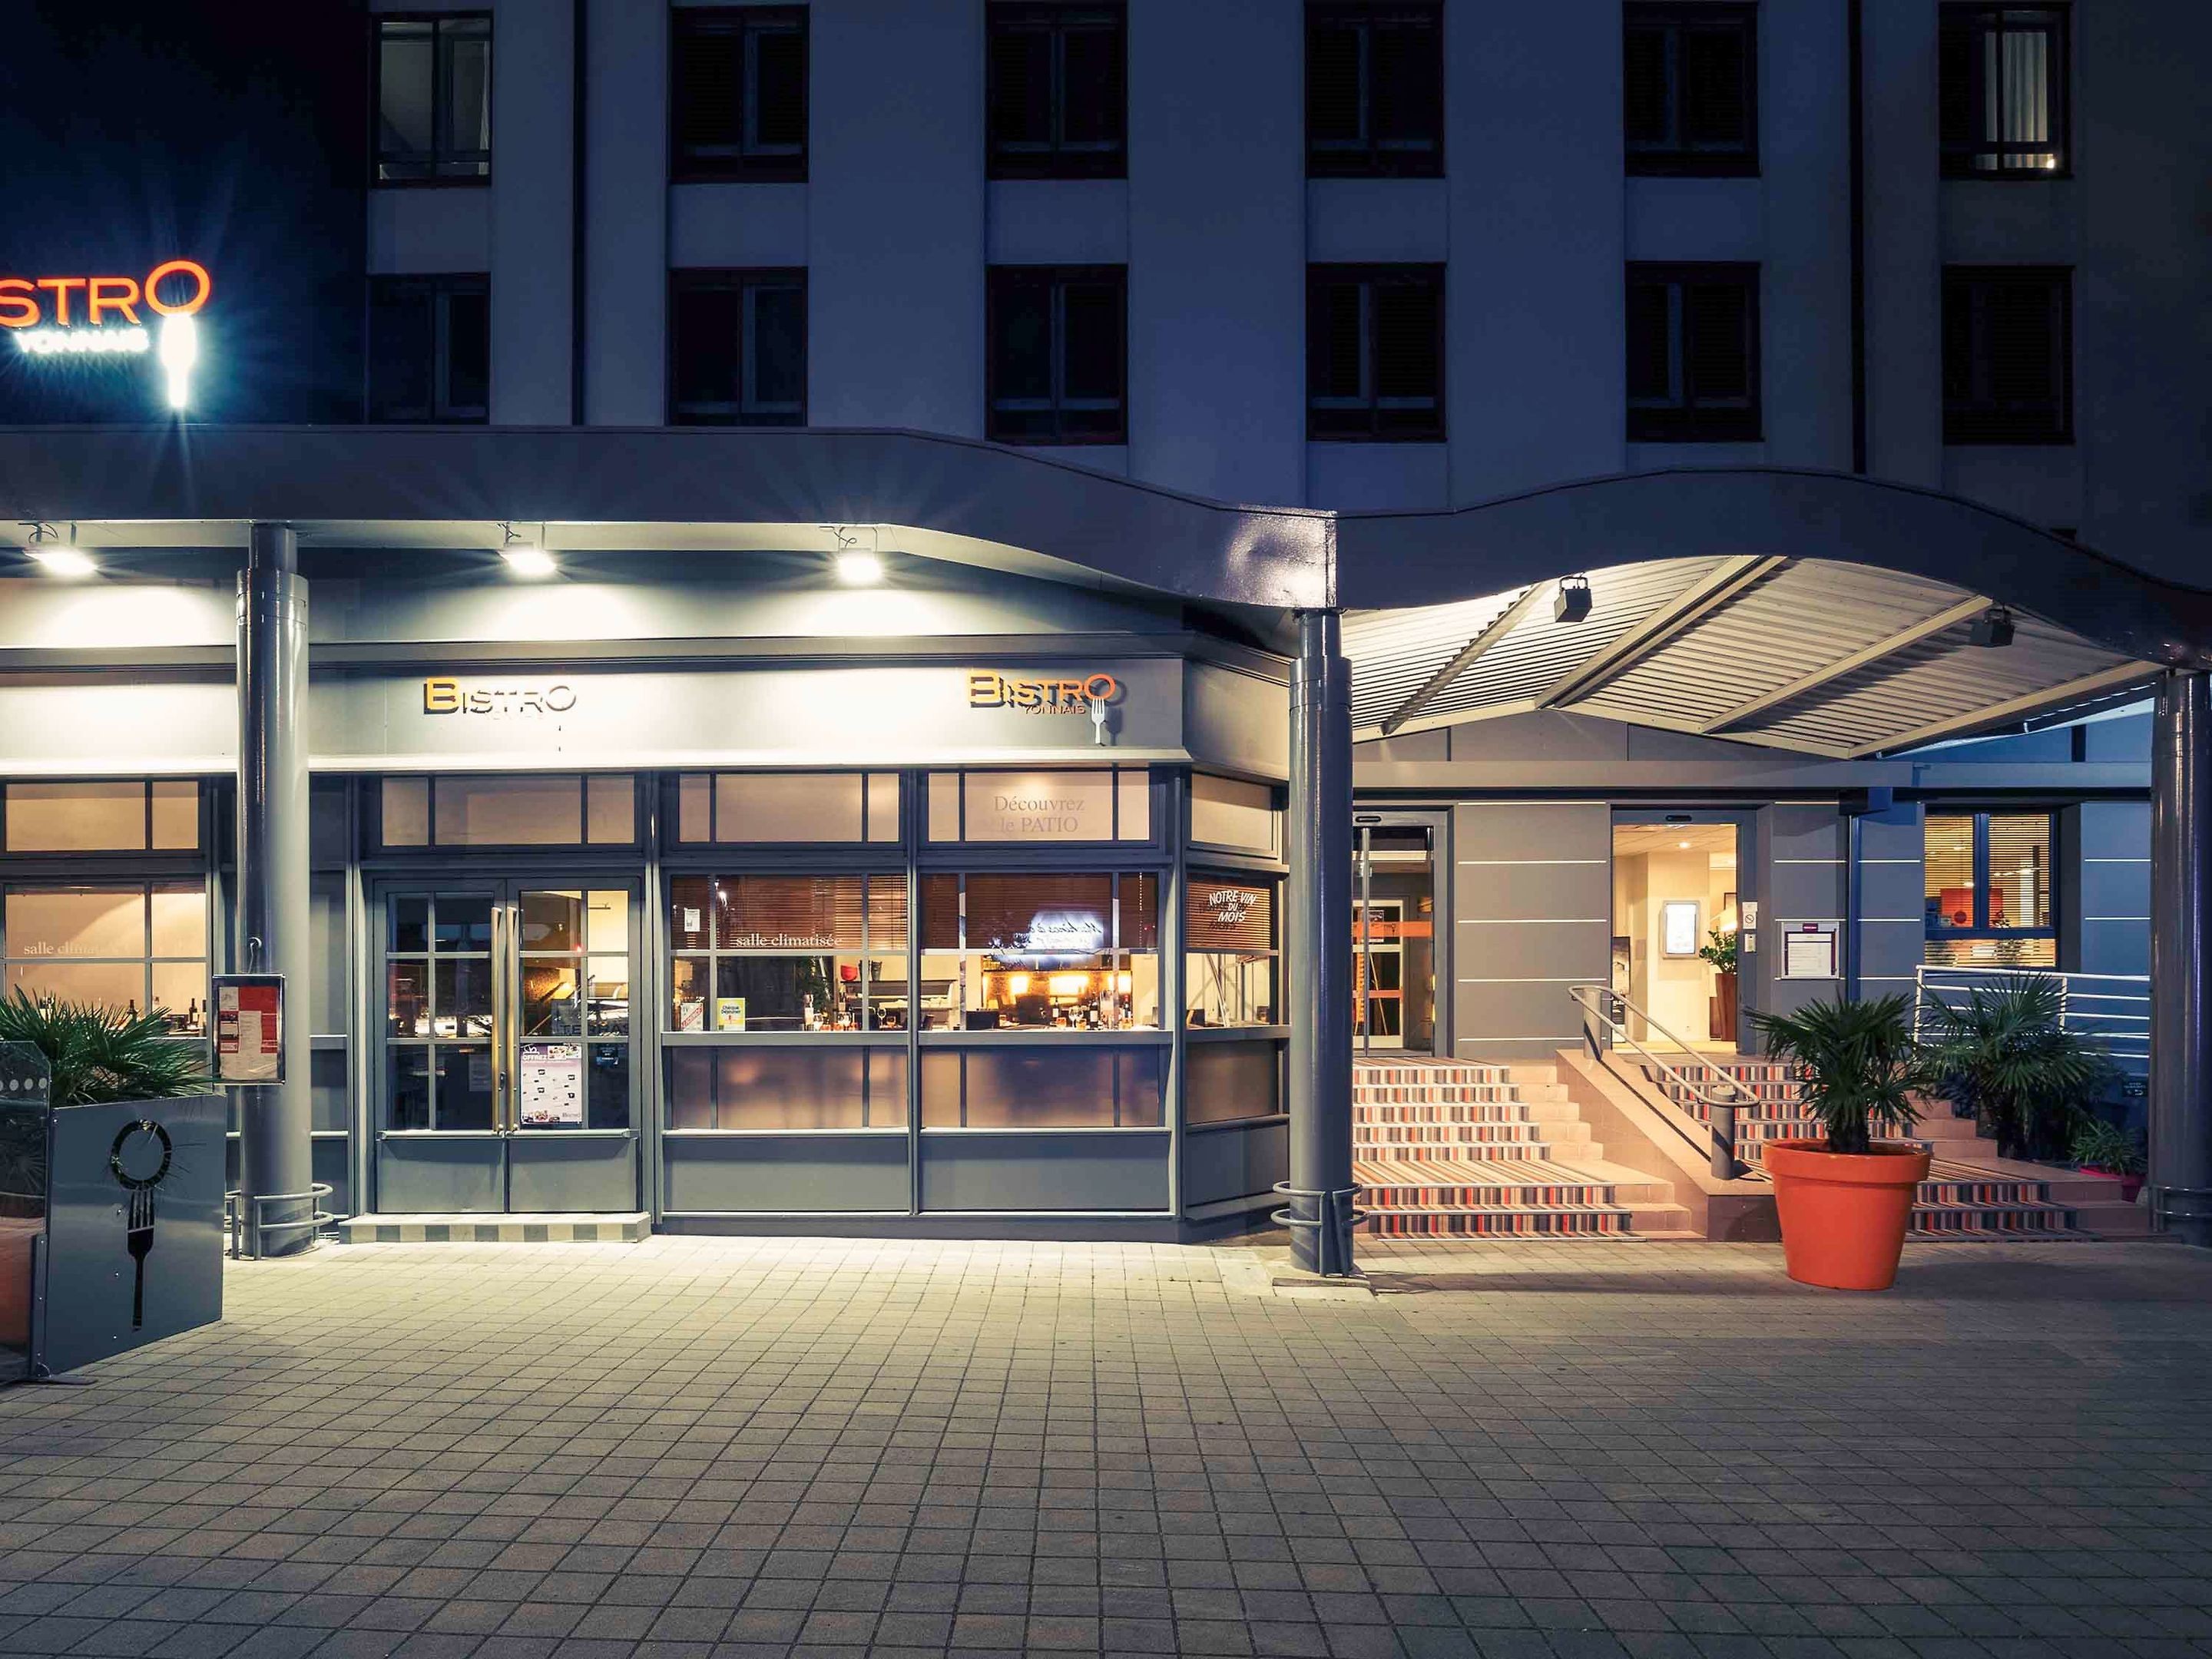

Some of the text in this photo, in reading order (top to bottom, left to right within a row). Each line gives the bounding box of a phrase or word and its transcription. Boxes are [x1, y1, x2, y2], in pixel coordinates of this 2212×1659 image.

[966, 670, 1117, 707] BISTRO
[994, 795, 1085, 812] Découvrez
[1021, 816, 1078, 833] PATIO
[1209, 890, 1257, 906] NOTRE VIN
[1227, 902, 1239, 912] DU
[1217, 911, 1247, 922] MOIS
[736, 932, 843, 947] salle climatisée
[23, 940, 55, 955] salle
